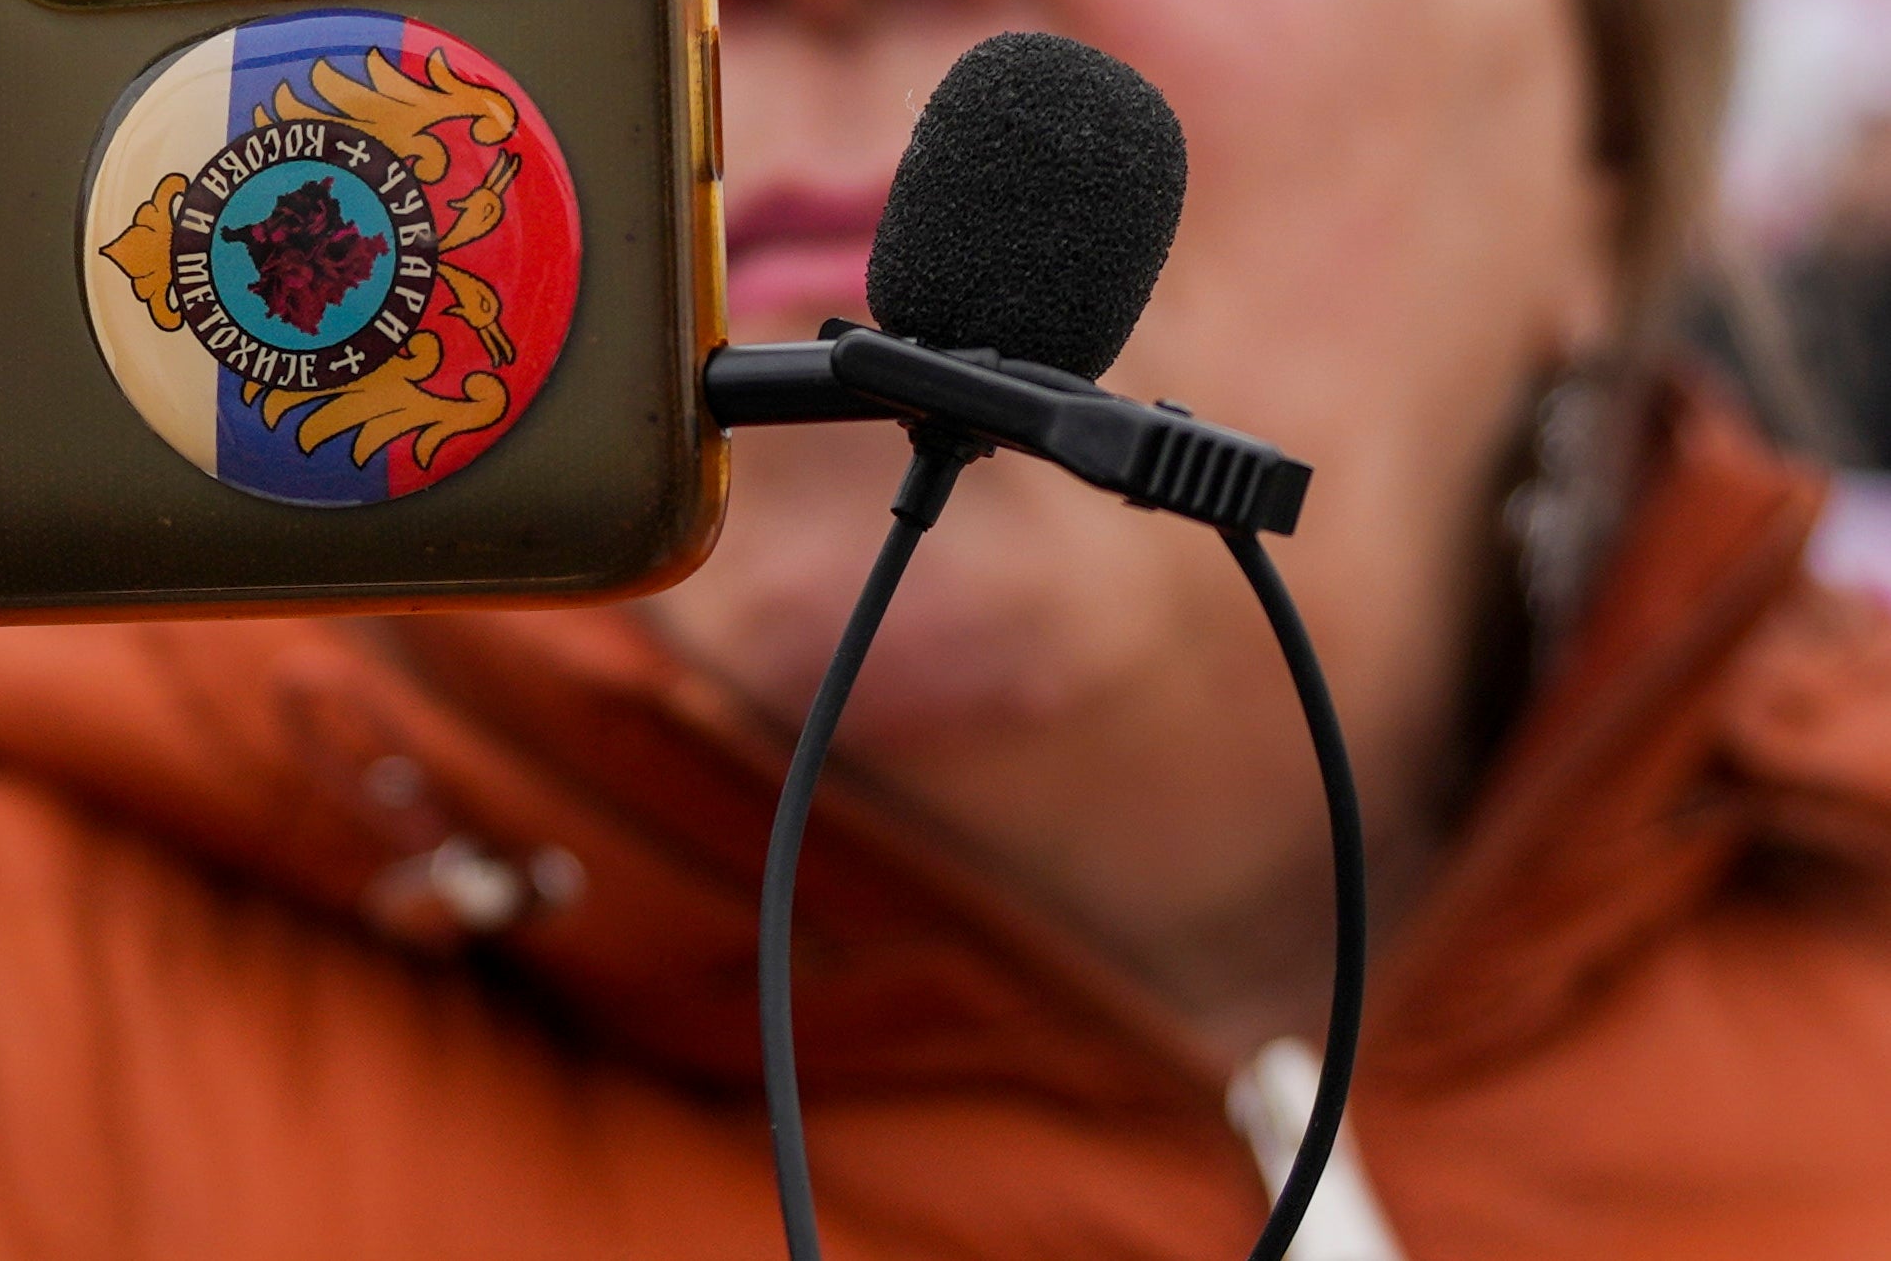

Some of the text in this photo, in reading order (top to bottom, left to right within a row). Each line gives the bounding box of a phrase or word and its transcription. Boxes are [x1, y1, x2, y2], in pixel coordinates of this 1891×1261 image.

[176, 124, 326, 389] КОСОВА И МЕТОХИЈЕ
[377, 161, 432, 346] ЧУВАРИ
